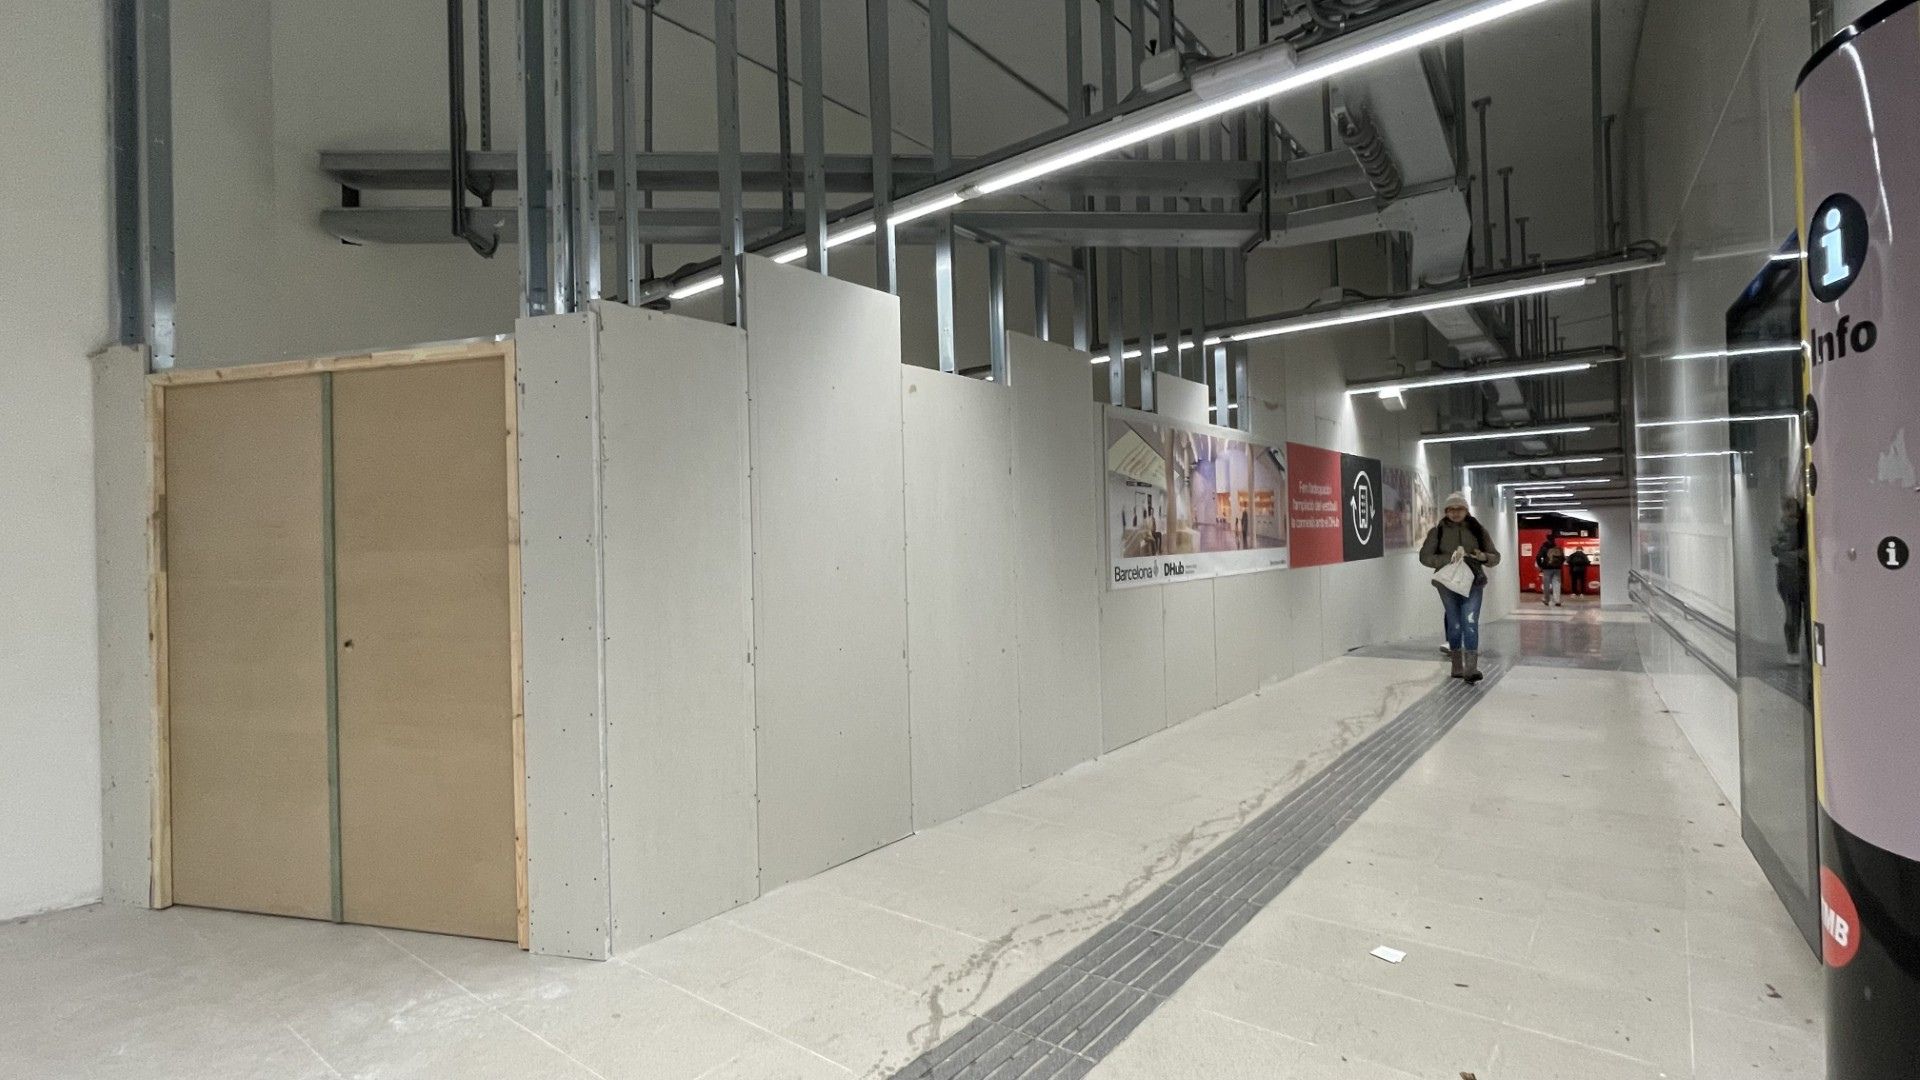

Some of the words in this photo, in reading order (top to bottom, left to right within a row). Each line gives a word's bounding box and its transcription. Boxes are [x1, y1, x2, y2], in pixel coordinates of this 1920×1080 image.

[1811, 315, 1877, 367] Info
[1114, 565, 1153, 582] Barcelona
[1164, 561, 1185, 577] DHub
[1821, 896, 1849, 947] MB
